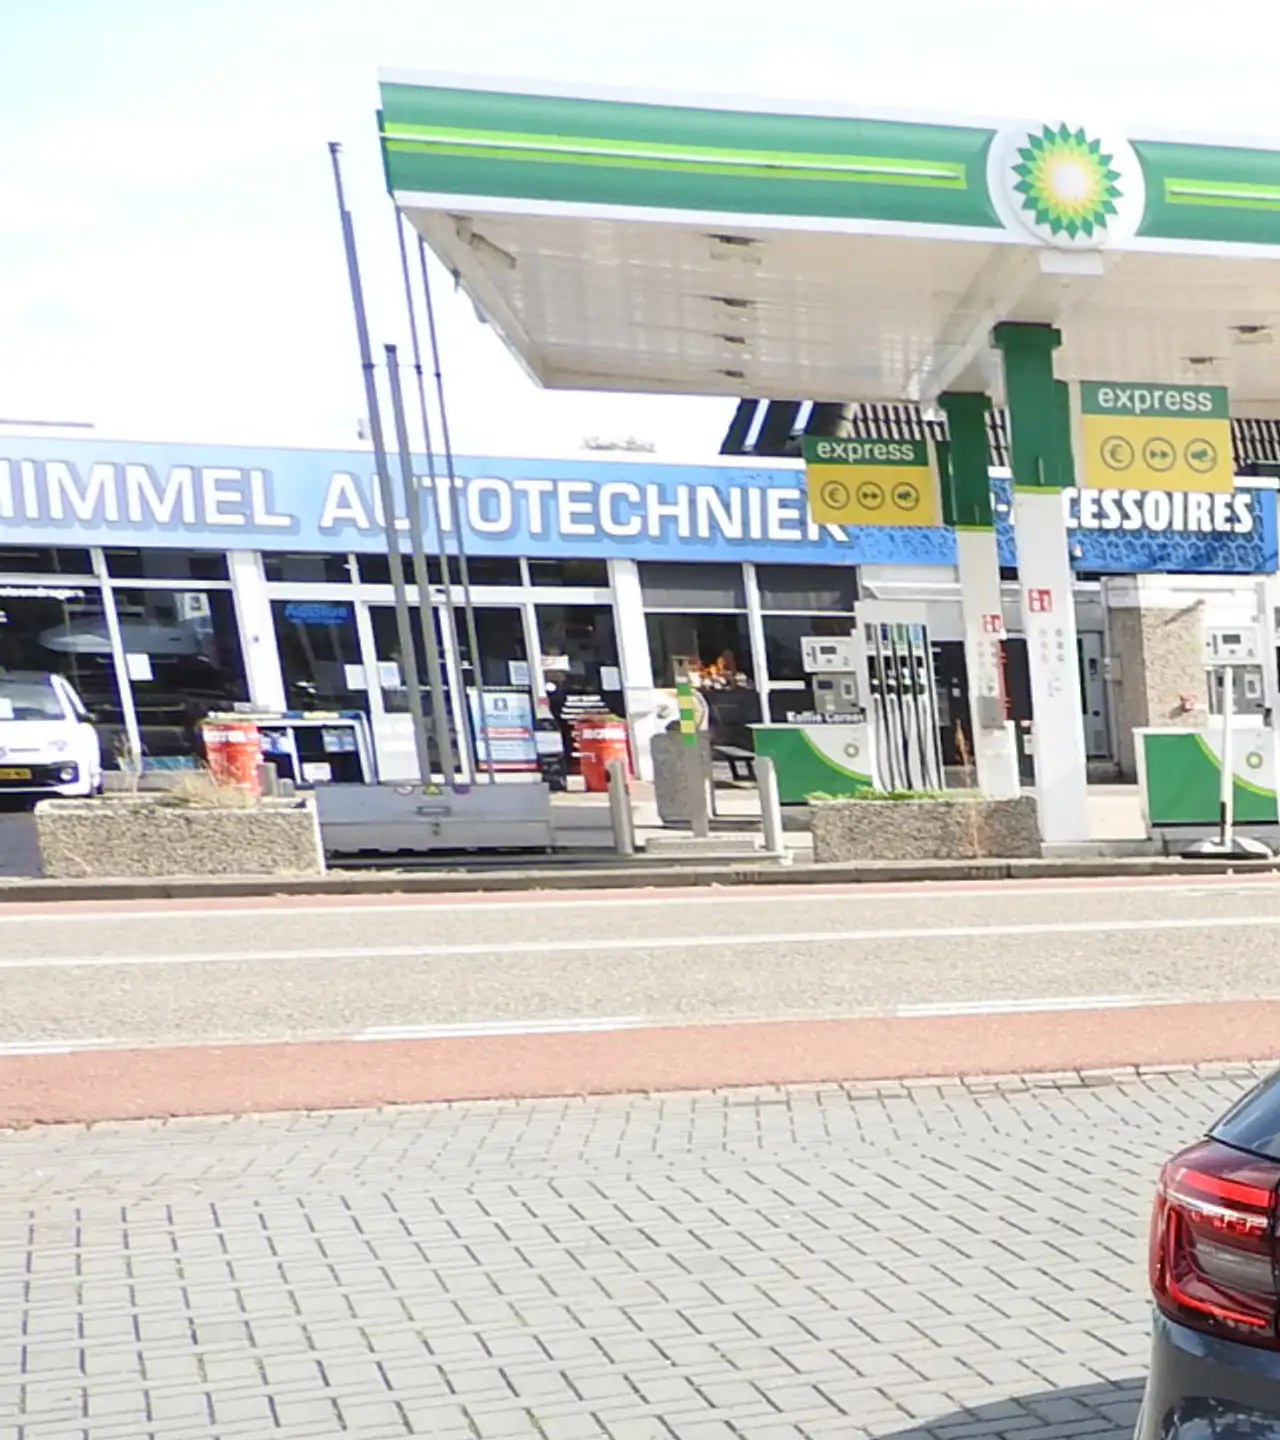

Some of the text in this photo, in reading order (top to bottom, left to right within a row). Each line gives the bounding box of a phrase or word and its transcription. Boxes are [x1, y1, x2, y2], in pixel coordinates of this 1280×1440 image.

[1097, 386, 1213, 414] express
[816, 441, 915, 463] express
[0, 457, 293, 527] IMMEL
